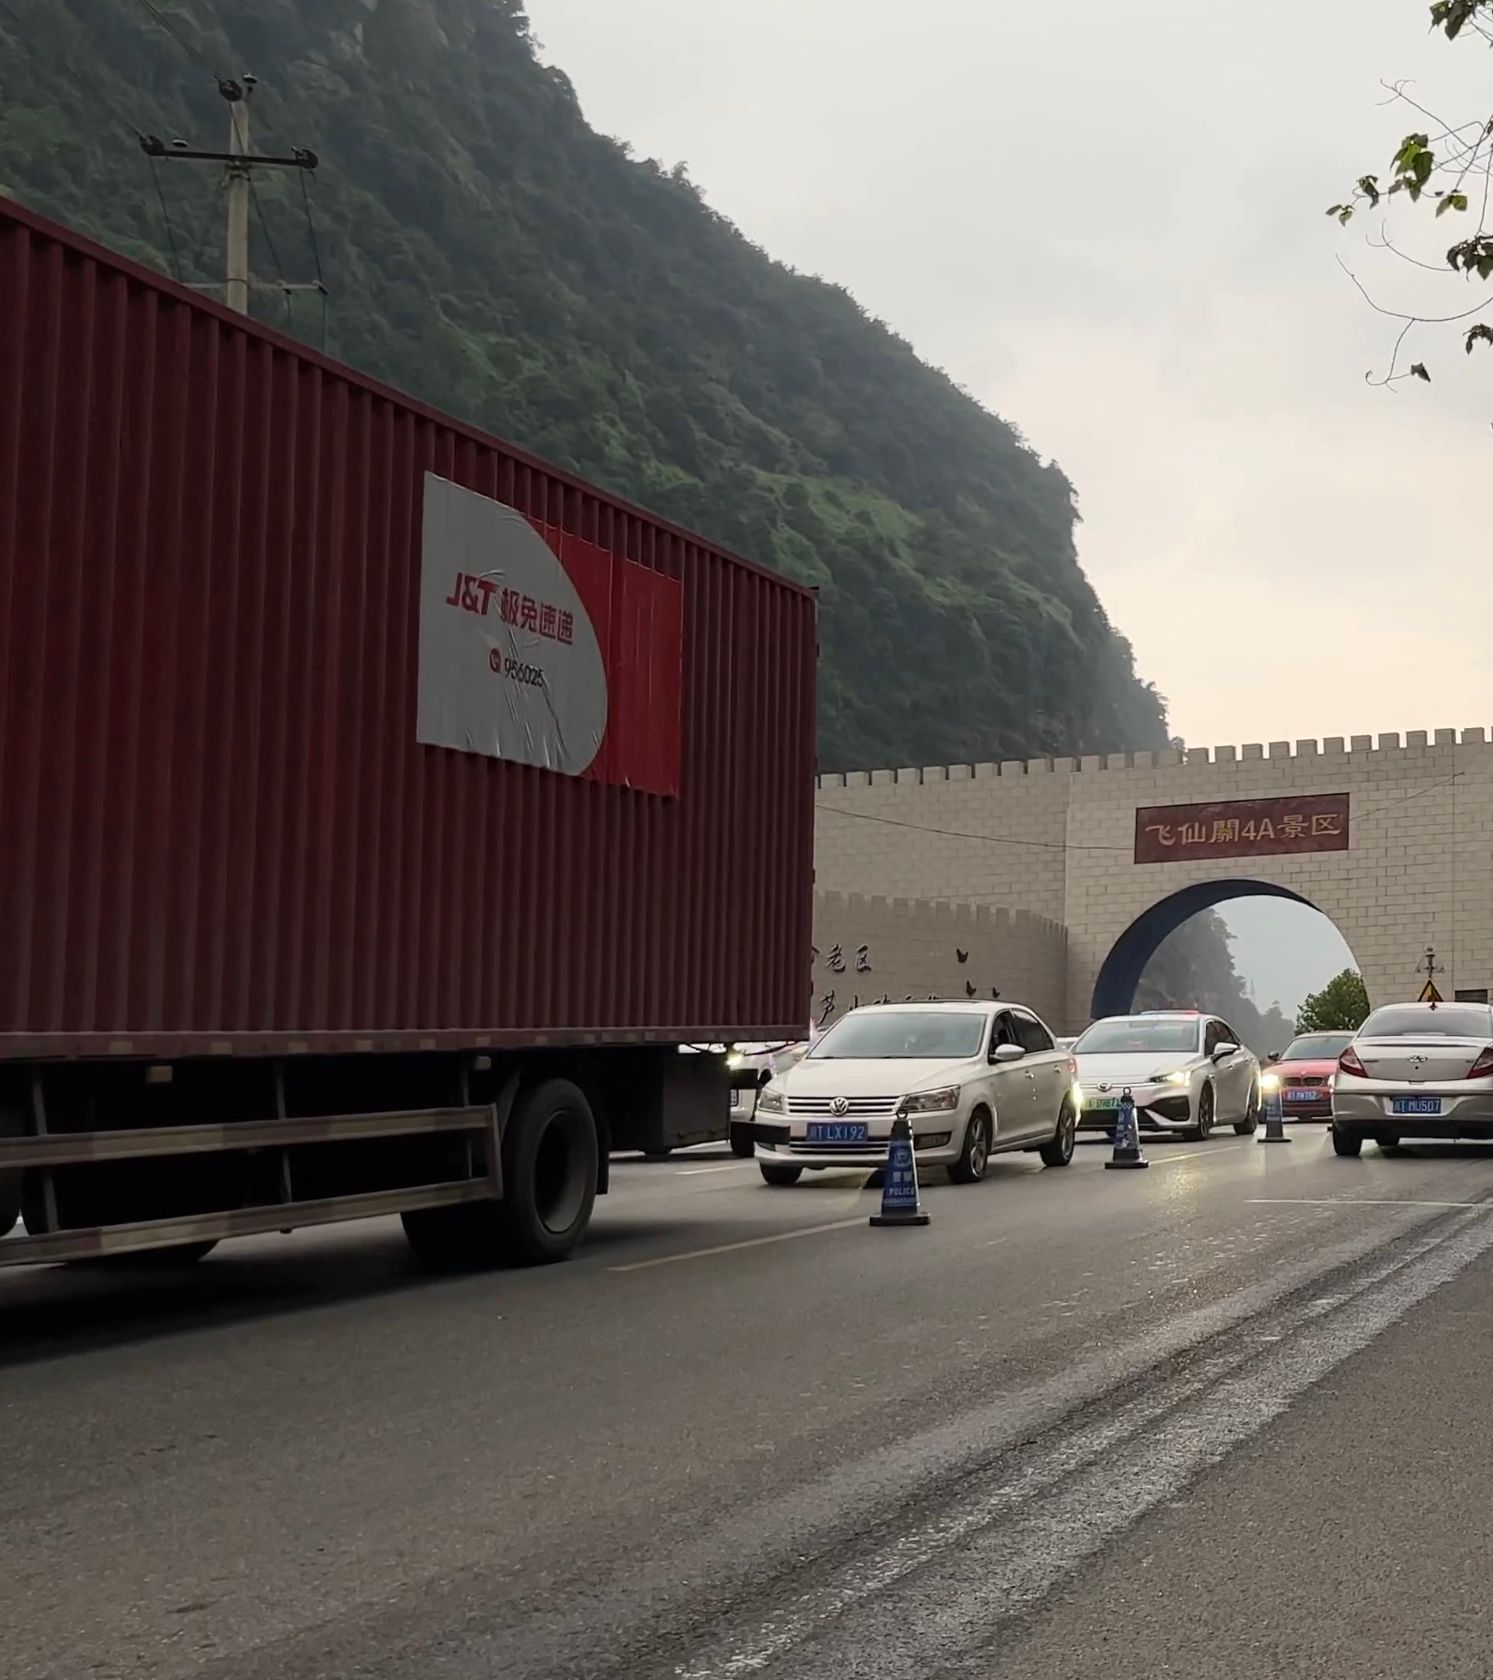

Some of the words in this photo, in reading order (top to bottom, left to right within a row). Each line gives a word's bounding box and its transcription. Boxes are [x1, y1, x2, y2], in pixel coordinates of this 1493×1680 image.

[446, 572, 500, 615] J&T
[501, 587, 574, 645] 极兔速递
[504, 657, 543, 687] 956025
[811, 943, 872, 974] 老区
